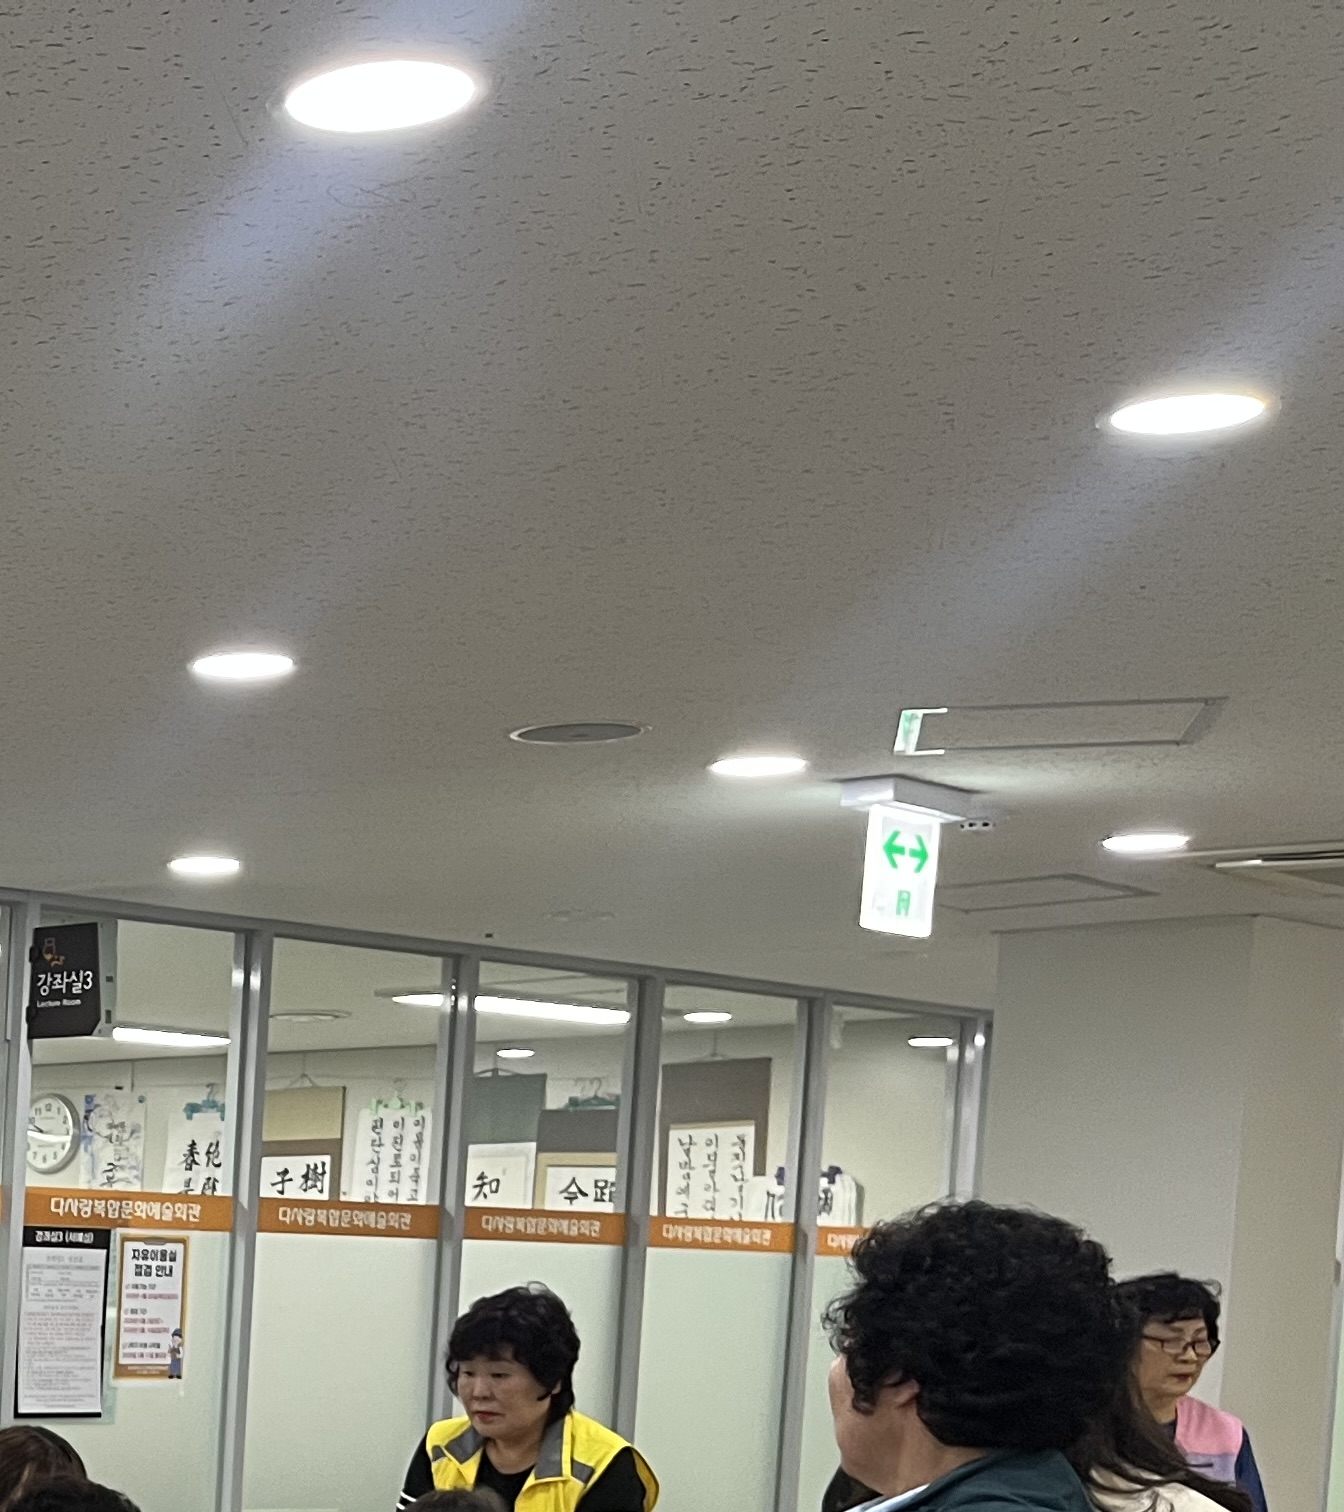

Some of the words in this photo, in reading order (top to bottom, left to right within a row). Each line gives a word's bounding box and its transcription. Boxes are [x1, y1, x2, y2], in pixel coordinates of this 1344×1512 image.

[36, 969, 93, 996] 강좌실3
[62, 998, 81, 1006] Room
[270, 1167, 294, 1196] 子
[50, 1197, 201, 1222] 다사랑복합문화예술회관
[155, 1264, 173, 1278] 안내
